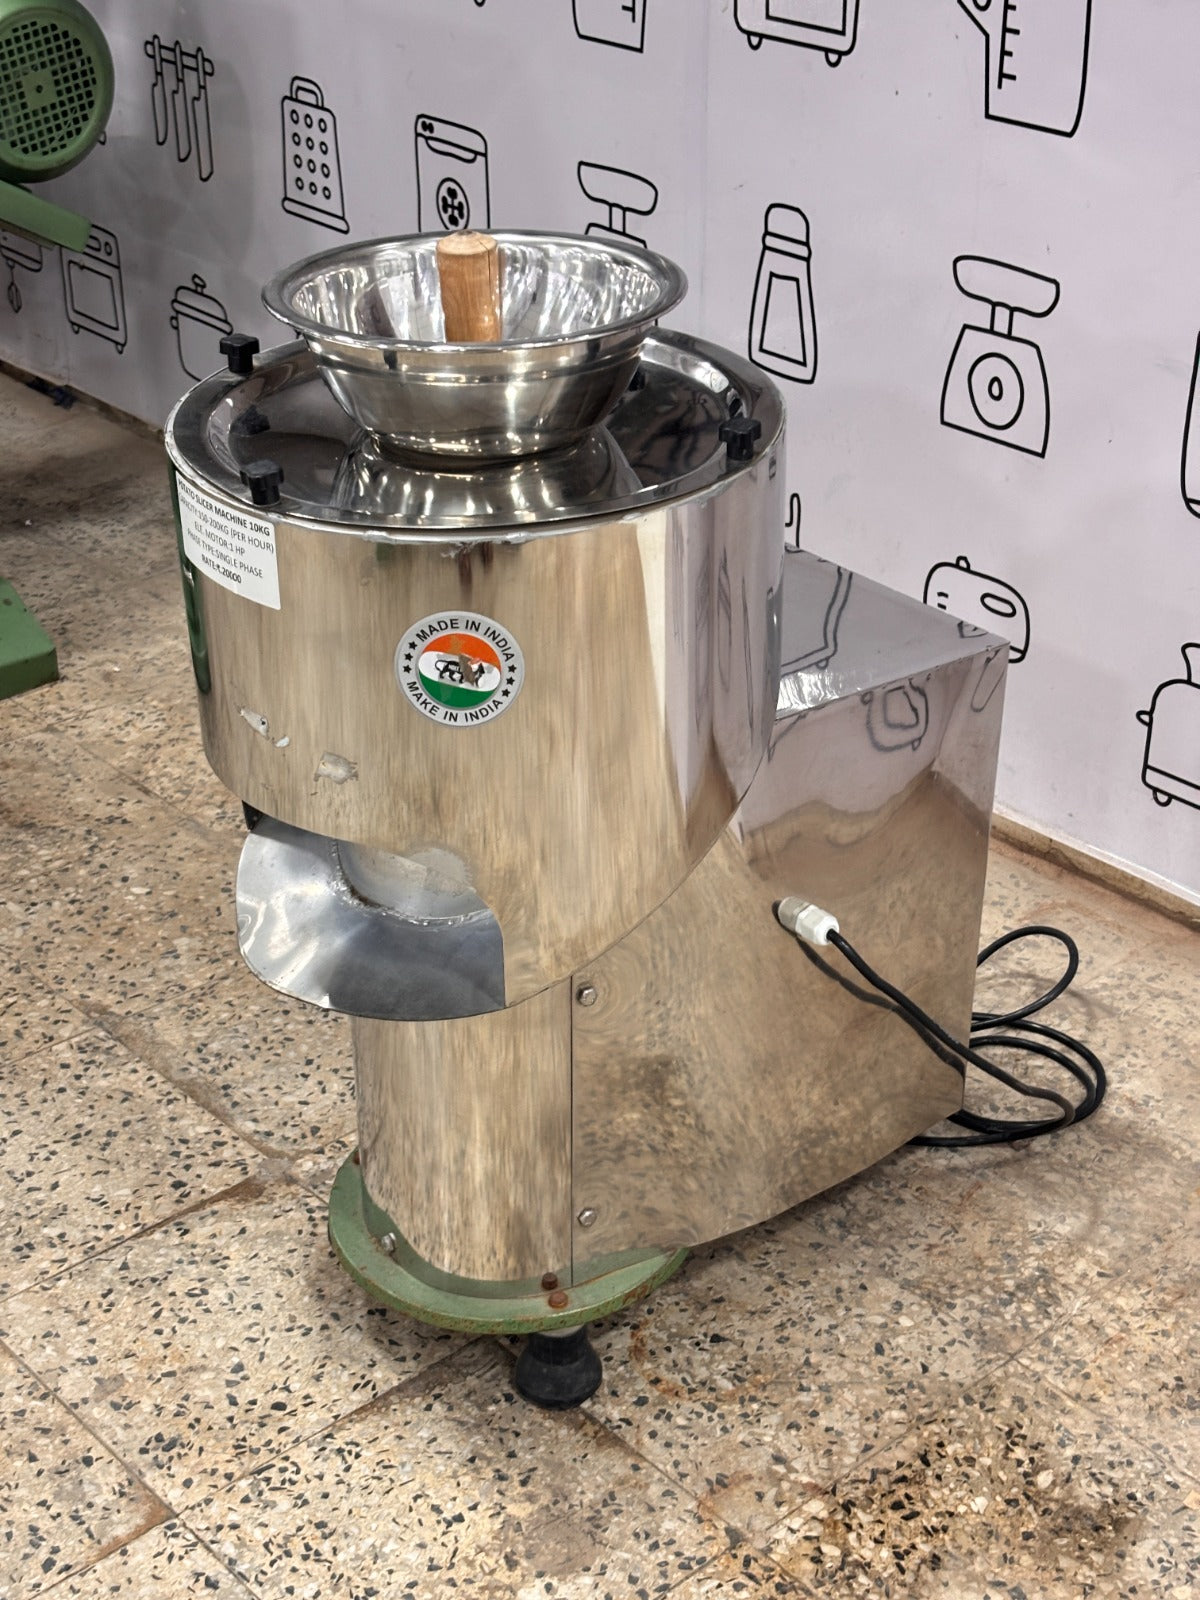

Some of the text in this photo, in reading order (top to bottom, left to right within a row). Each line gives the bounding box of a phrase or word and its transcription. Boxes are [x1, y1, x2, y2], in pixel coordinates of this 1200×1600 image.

[195, 493, 214, 513] SLICER
[214, 505, 248, 528] MACHINE
[249, 522, 270, 536] 10KG
[230, 528, 246, 543] (PER
[248, 537, 274, 553] HOUR)
[236, 543, 245, 555] HP
[239, 561, 263, 578] PHASE
[416, 619, 515, 662] MADE IN INDIA
[407, 682, 503, 722] MAKE IN INDIA
